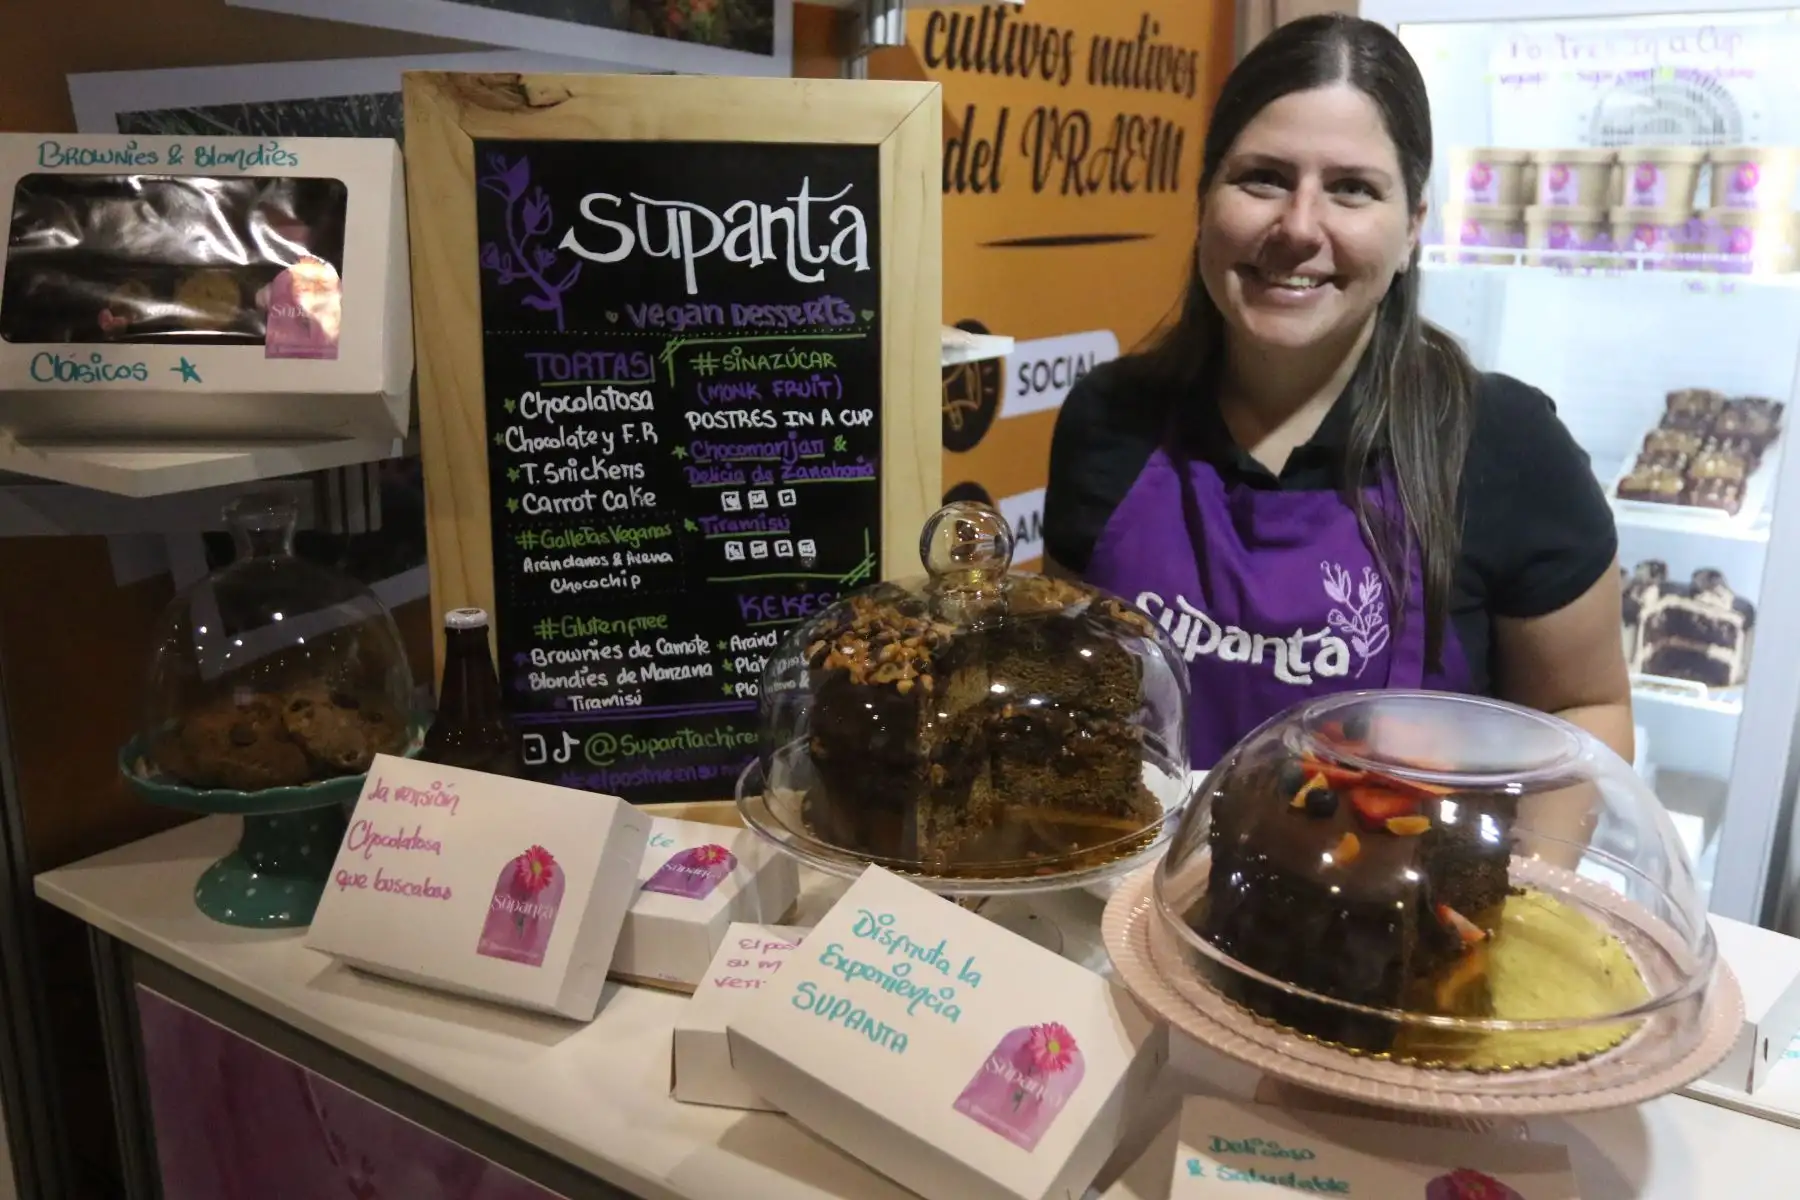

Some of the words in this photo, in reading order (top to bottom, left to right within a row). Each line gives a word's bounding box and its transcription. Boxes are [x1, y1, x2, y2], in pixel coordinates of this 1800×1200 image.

[924, 3, 1073, 87] cultivos
[1089, 12, 1198, 99] nativos
[167, 144, 183, 166] &
[194, 140, 299, 170] Blondies
[942, 104, 1009, 195] del
[1021, 105, 1185, 197] VRAEM
[558, 176, 871, 294] Supanta
[30, 352, 149, 383] Clásicos
[524, 351, 650, 381] TORTAS
[520, 386, 654, 424] Chocolatosa
[684, 408, 777, 431] POSTRES
[782, 410, 814, 427] IN
[821, 408, 835, 426] A
[839, 408, 874, 427] CUP
[505, 424, 598, 453] Chocolate
[833, 435, 847, 452] &
[520, 463, 540, 485] T.
[543, 455, 645, 484] Snickers
[752, 464, 774, 483] de
[522, 489, 597, 515] Carrot
[602, 484, 657, 512] Cake
[523, 554, 609, 573] Arándanos
[612, 551, 623, 567] &
[627, 551, 673, 566] Avena
[530, 638, 623, 667] Brownies
[628, 640, 653, 659] de
[656, 633, 711, 656] Camote
[528, 666, 609, 691] Blondies
[616, 667, 638, 686] de
[641, 662, 713, 683] Manzana
[347, 819, 441, 860] Chocolatosa
[336, 869, 368, 892] que
[852, 909, 950, 976] Disfruta
[957, 956, 983, 989] la
[818, 943, 962, 1024] Experiencia
[792, 981, 909, 1054] SUPANTA
